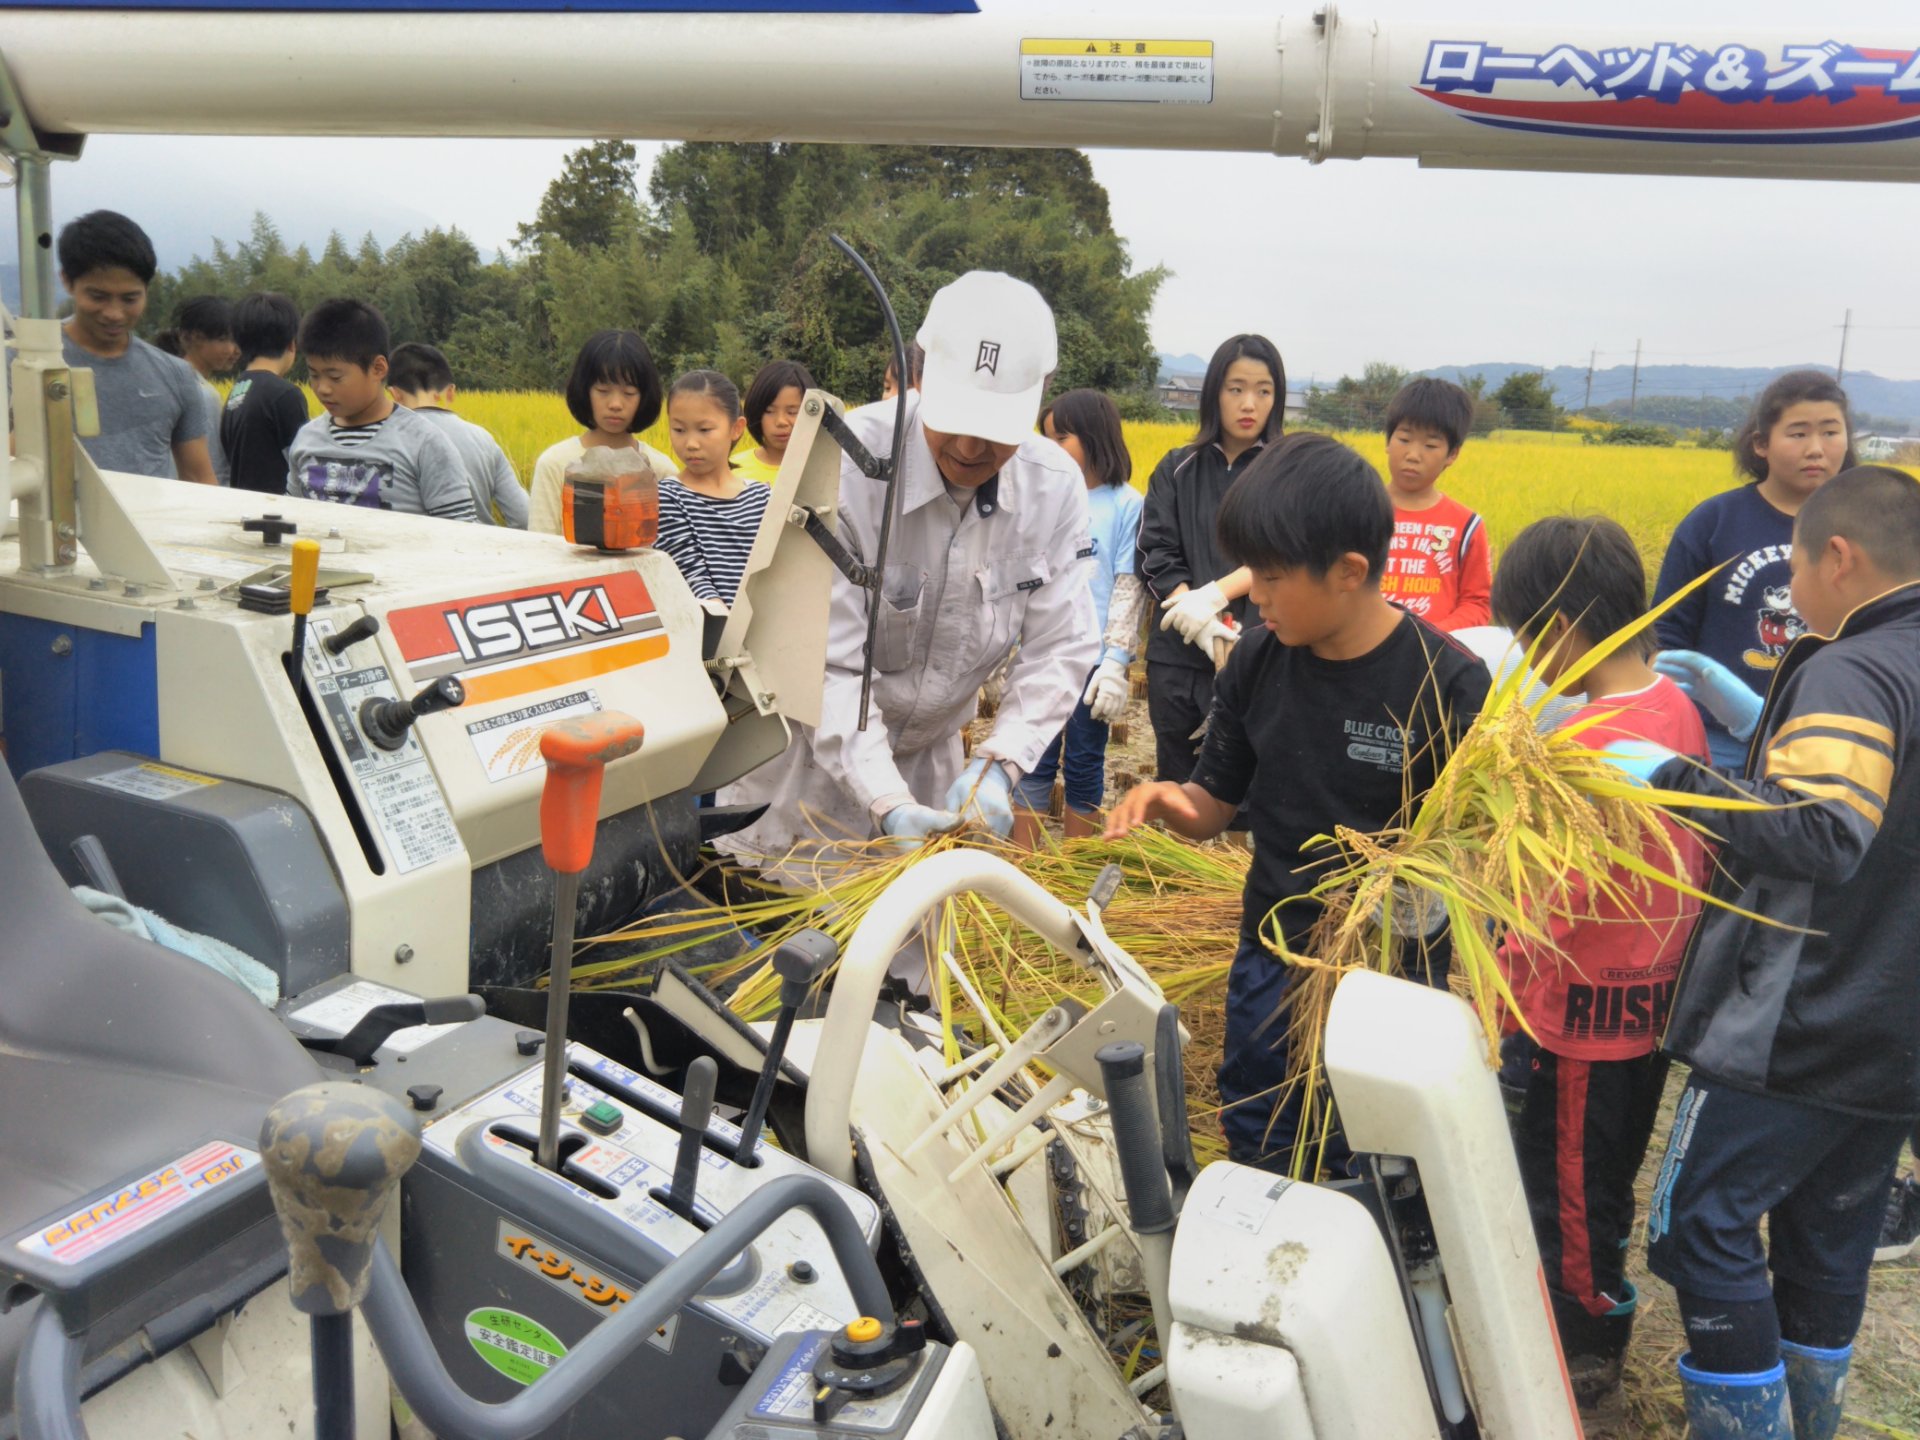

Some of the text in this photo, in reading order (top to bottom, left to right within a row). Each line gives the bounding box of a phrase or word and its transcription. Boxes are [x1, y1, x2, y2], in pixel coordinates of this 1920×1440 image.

[1109, 41, 1146, 54] 注意
[1399, 558, 1427, 575] THE
[1402, 576, 1442, 594] HOUR
[445, 586, 622, 662] ISEKI
[339, 668, 386, 688] オーガ操作
[1343, 719, 1416, 744] BLUE CROS
[1561, 980, 1676, 1040] RUSH
[489, 1313, 552, 1347] 生研センター
